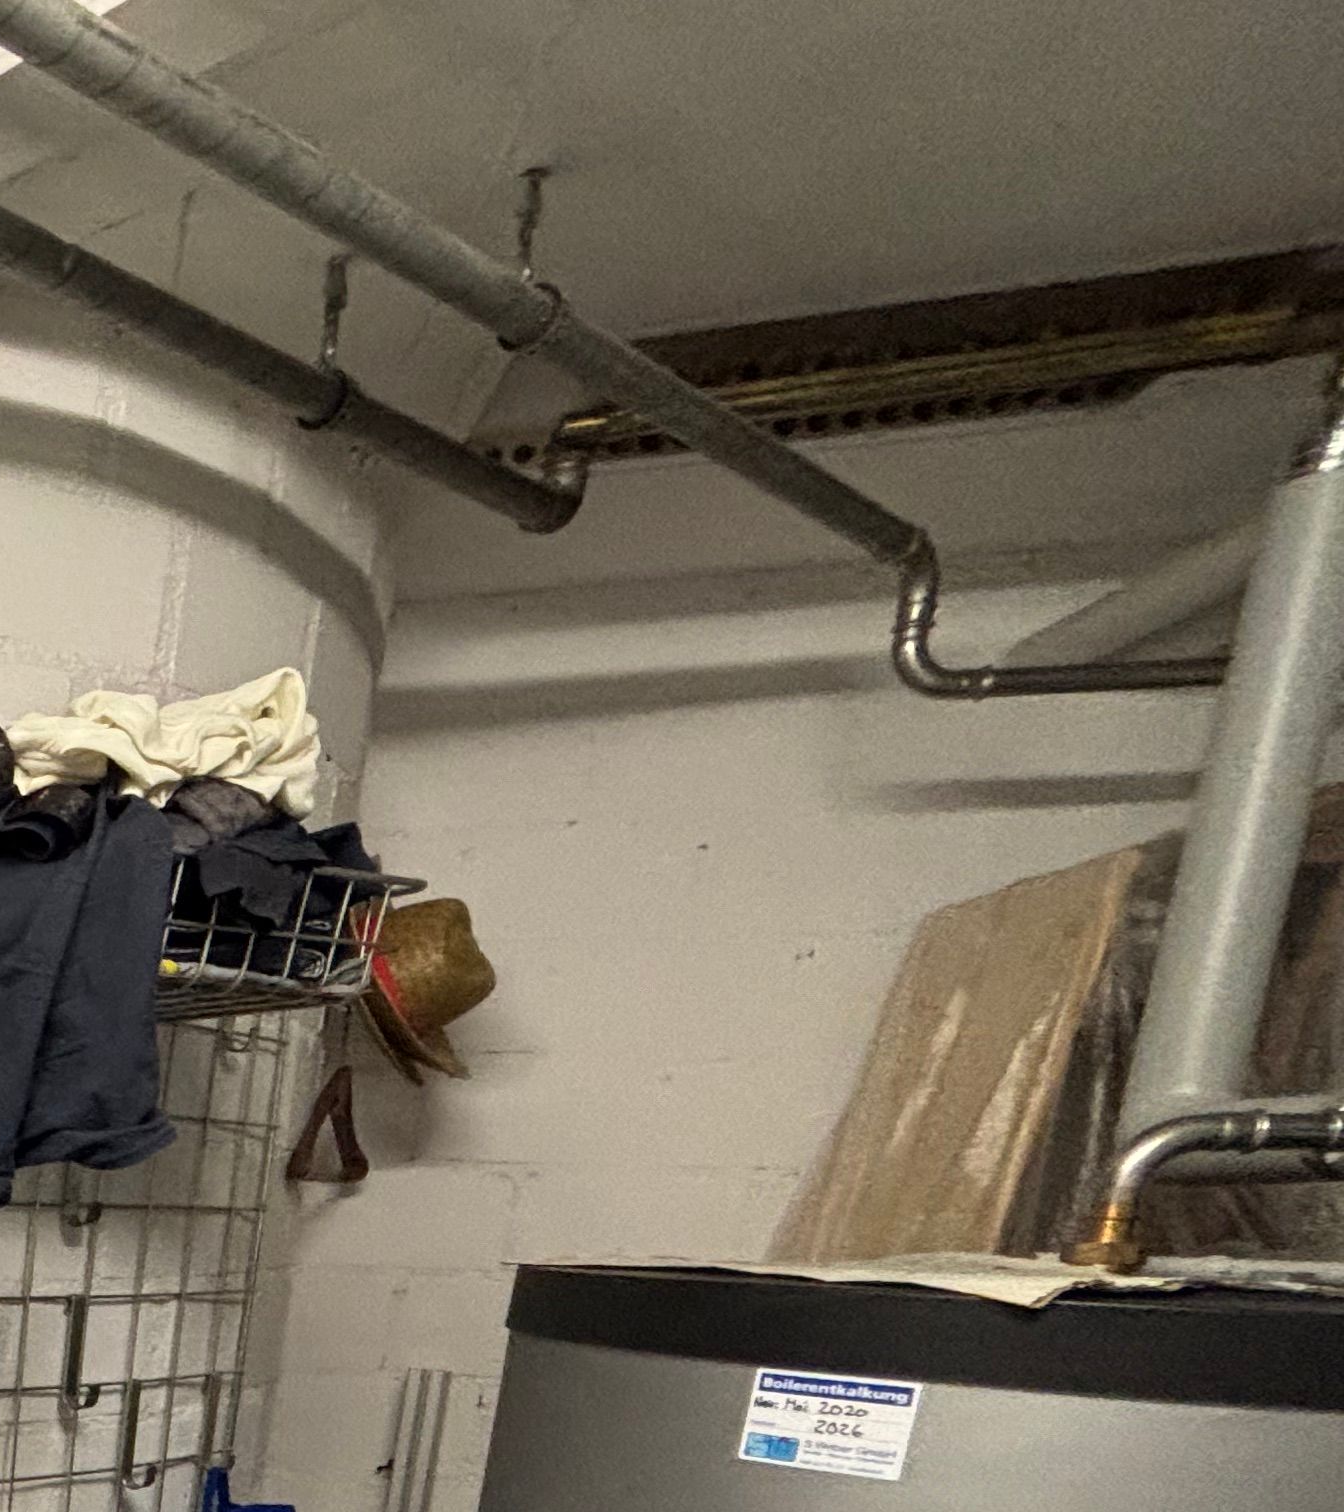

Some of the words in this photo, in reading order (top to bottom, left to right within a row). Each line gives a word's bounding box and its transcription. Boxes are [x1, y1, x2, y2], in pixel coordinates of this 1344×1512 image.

[762, 1376, 910, 1404] Boilerentkalkung
[819, 1401, 869, 1418] 2020
[814, 1420, 863, 1438] 2026
